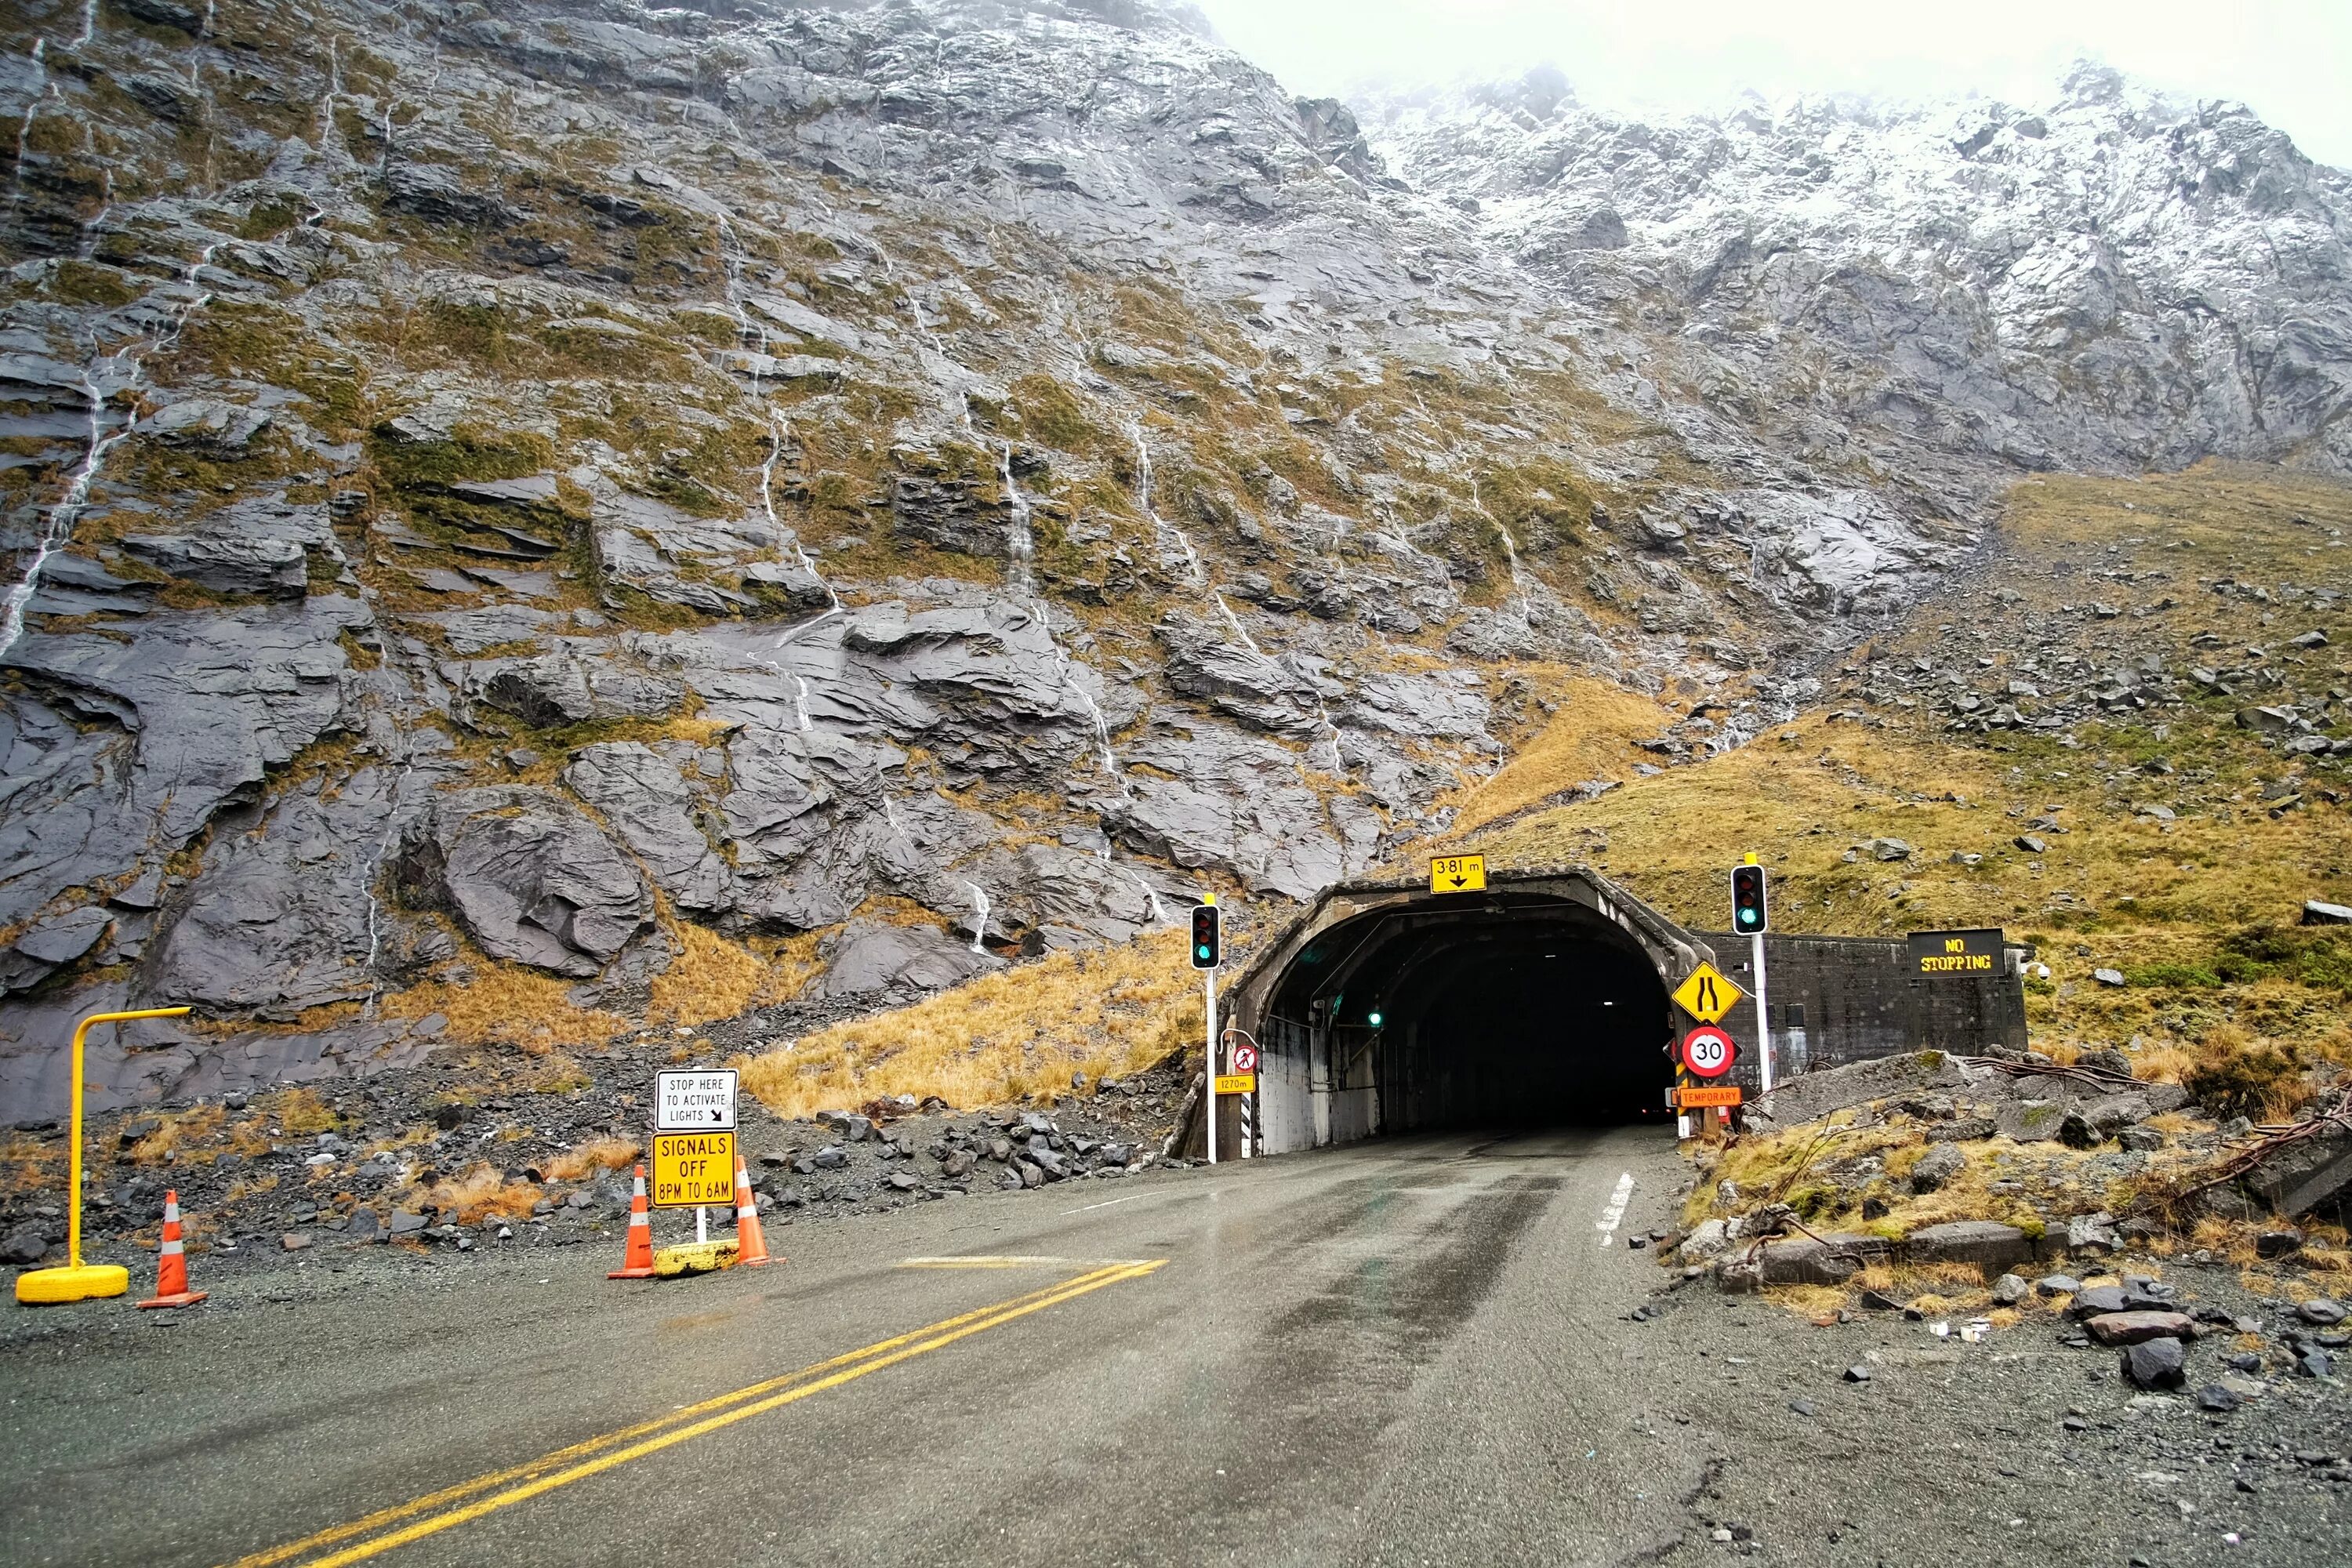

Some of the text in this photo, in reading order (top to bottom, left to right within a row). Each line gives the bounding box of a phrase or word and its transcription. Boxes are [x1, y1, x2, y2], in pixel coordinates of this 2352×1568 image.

[1944, 938, 1964, 953] NO
[1921, 954, 1991, 971] STOPPING
[1696, 1043, 1722, 1060] 30
[670, 1079, 724, 1091] STOP HERE
[1221, 1080, 1247, 1088] 1270m
[667, 1094, 726, 1106] TO ACTIVATE
[1683, 1091, 1737, 1102] TEMPORARY
[670, 1110, 703, 1121] LIGHTS
[662, 1137, 727, 1156] SIGNALS
[680, 1160, 708, 1177] OFF
[659, 1181, 729, 1200] 8PM TO 6AM
